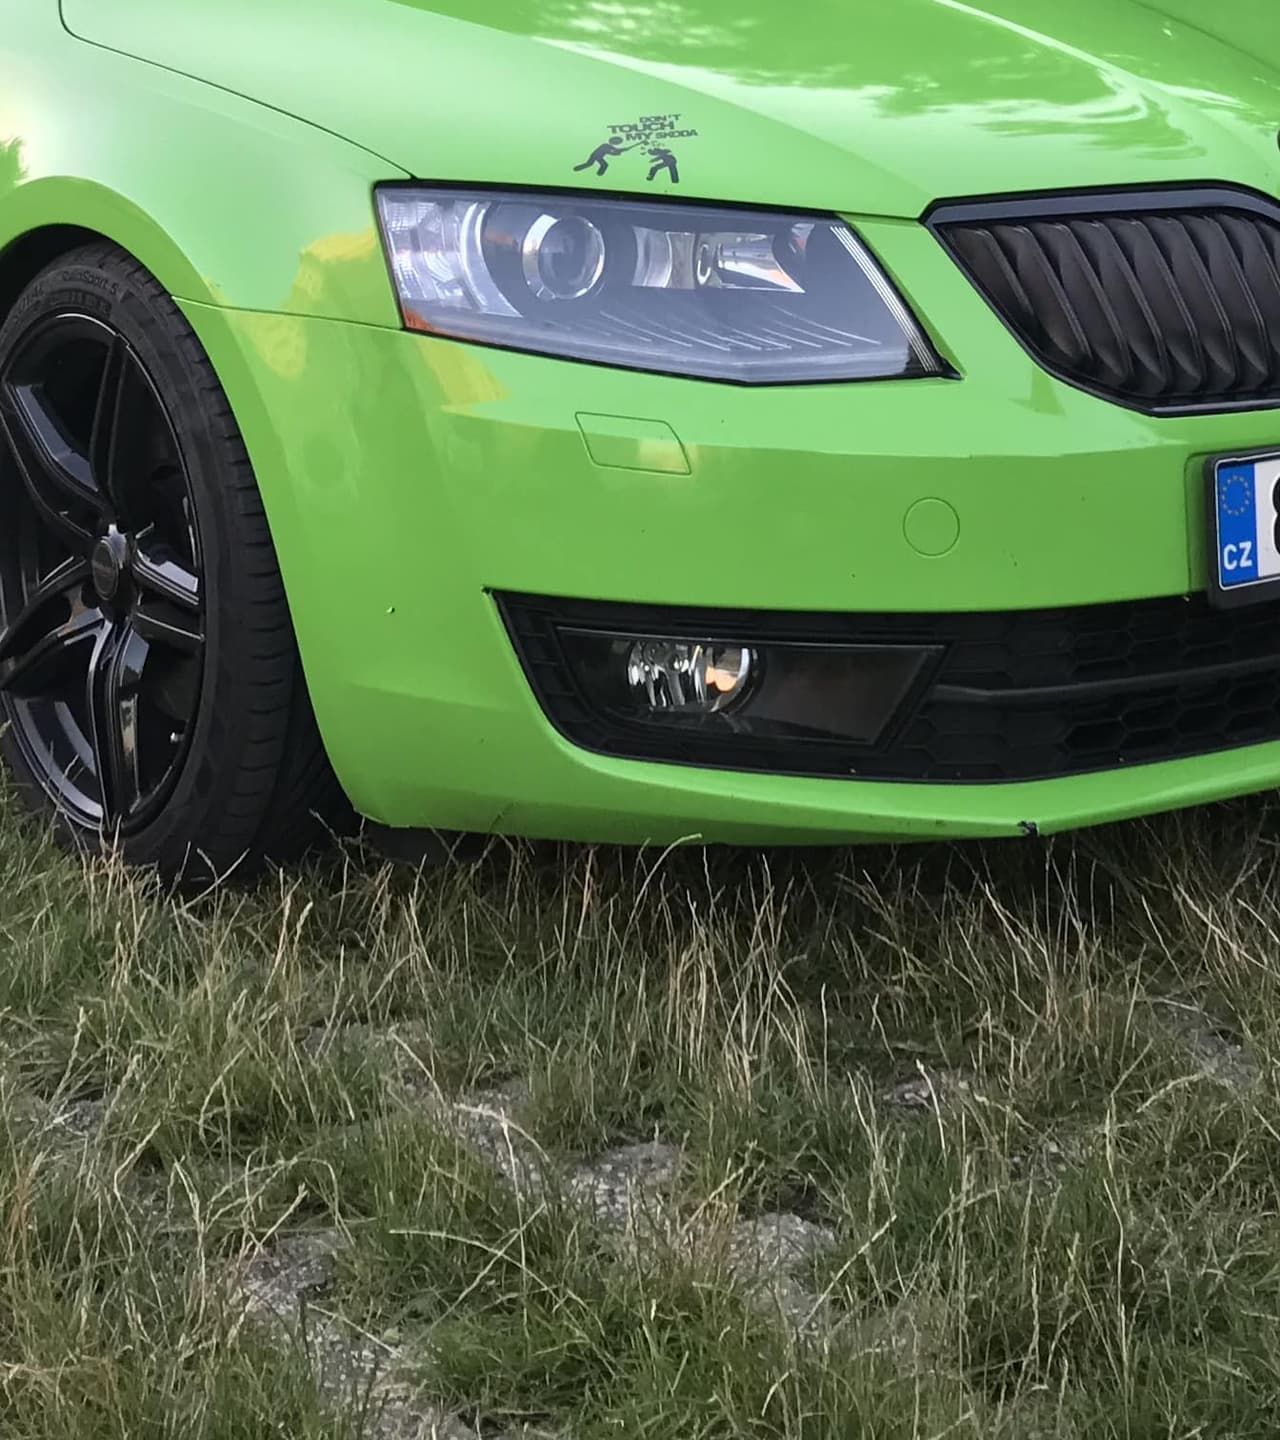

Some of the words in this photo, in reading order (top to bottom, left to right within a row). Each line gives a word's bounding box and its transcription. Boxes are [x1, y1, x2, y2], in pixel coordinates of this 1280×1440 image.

[639, 113, 681, 123] DON'T
[607, 121, 675, 134] TOUCH
[626, 132, 653, 141] MY
[655, 129, 699, 139] SKODA
[1223, 541, 1253, 571] CZ
